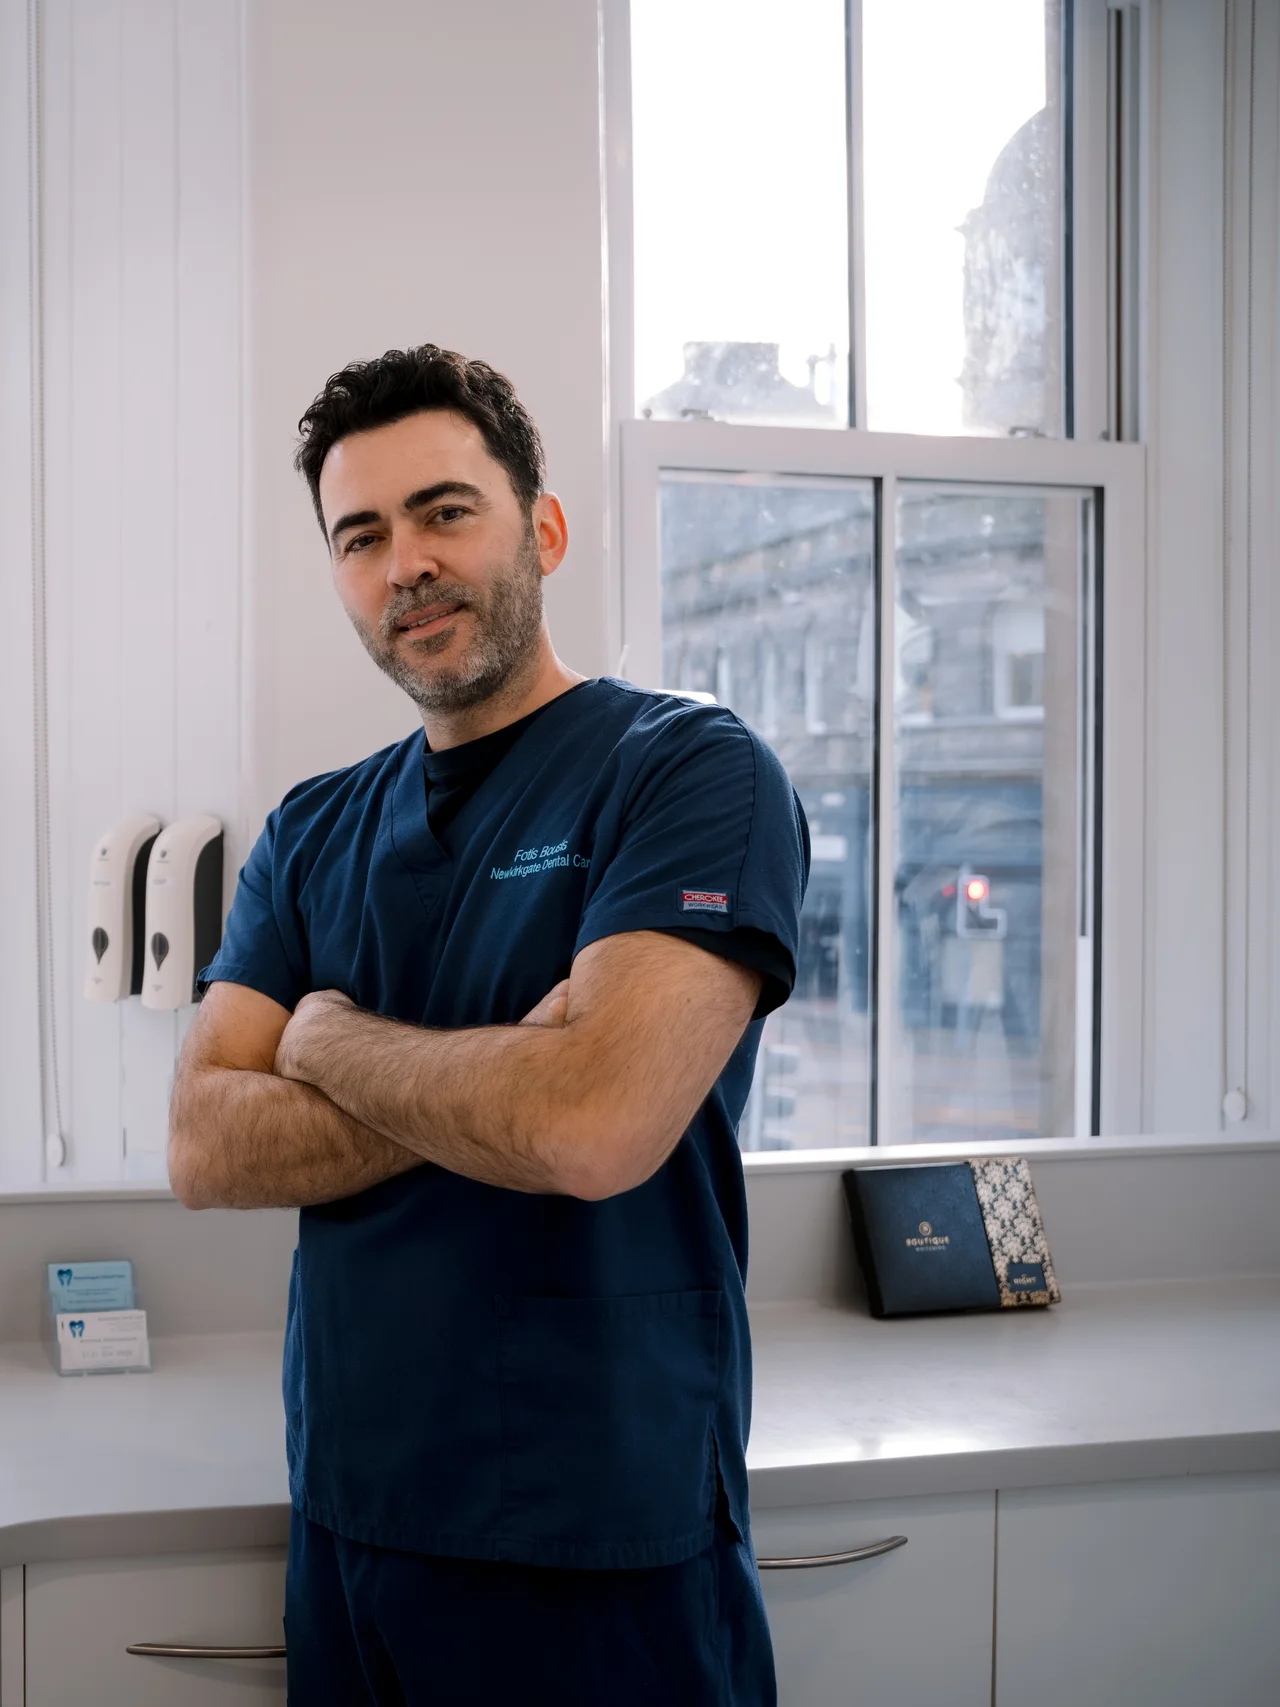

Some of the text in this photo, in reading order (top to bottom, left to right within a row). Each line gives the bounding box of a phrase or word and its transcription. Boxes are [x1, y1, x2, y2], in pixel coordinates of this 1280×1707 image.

[514, 848, 539, 862] Fotis
[490, 853, 593, 880] Newkirkgate Dental Car
[684, 893, 724, 904] CHEROKEE
[688, 902, 723, 910] WORKWEAR
